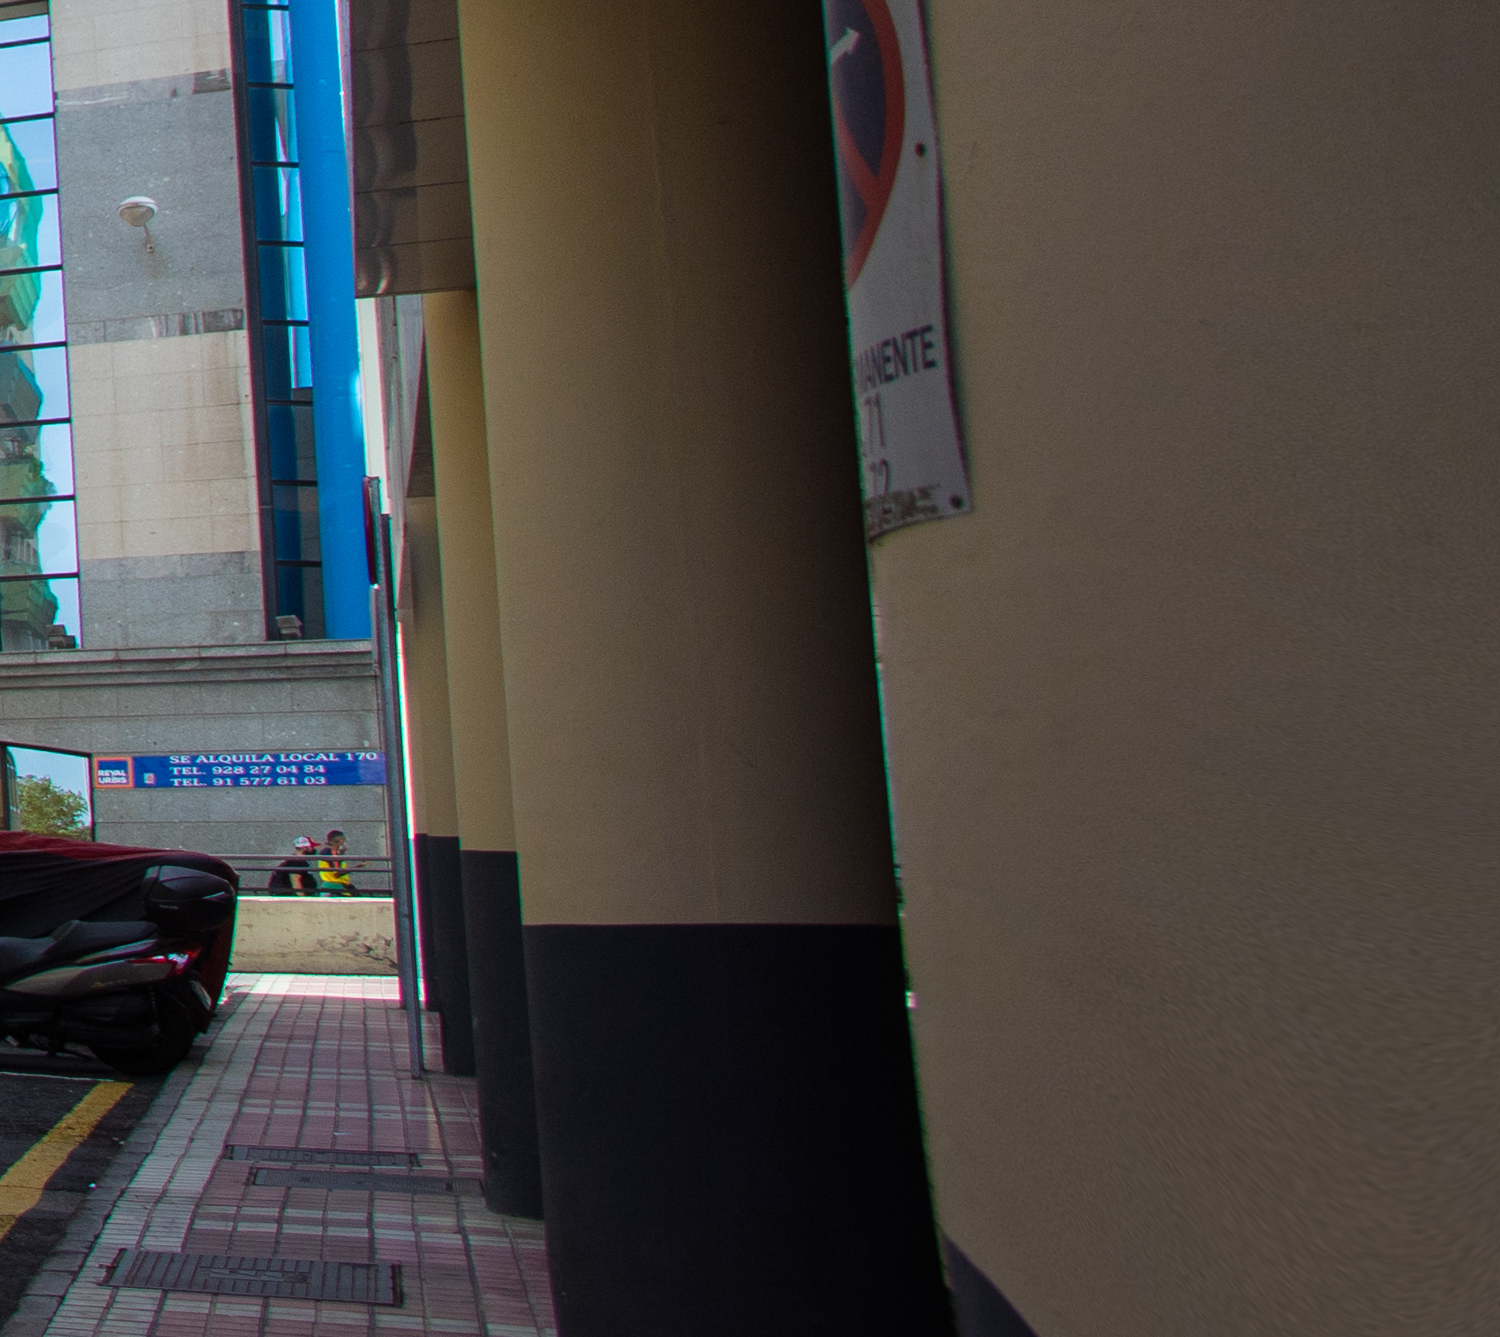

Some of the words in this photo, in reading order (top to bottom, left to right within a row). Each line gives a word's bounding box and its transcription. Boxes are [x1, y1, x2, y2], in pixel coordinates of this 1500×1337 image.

[169, 755, 191, 764] SE
[195, 754, 275, 765] ALQUILA
[280, 752, 340, 763] LOCAL
[345, 752, 378, 761] 170
[169, 767, 207, 775] TEL.
[212, 766, 245, 775] 928
[249, 765, 272, 774] 27
[276, 765, 299, 774] 04
[170, 778, 207, 786] TEL.
[212, 778, 233, 786] 91
[240, 777, 272, 785] 577
[277, 777, 298, 785] 61
[303, 776, 327, 785] 03
